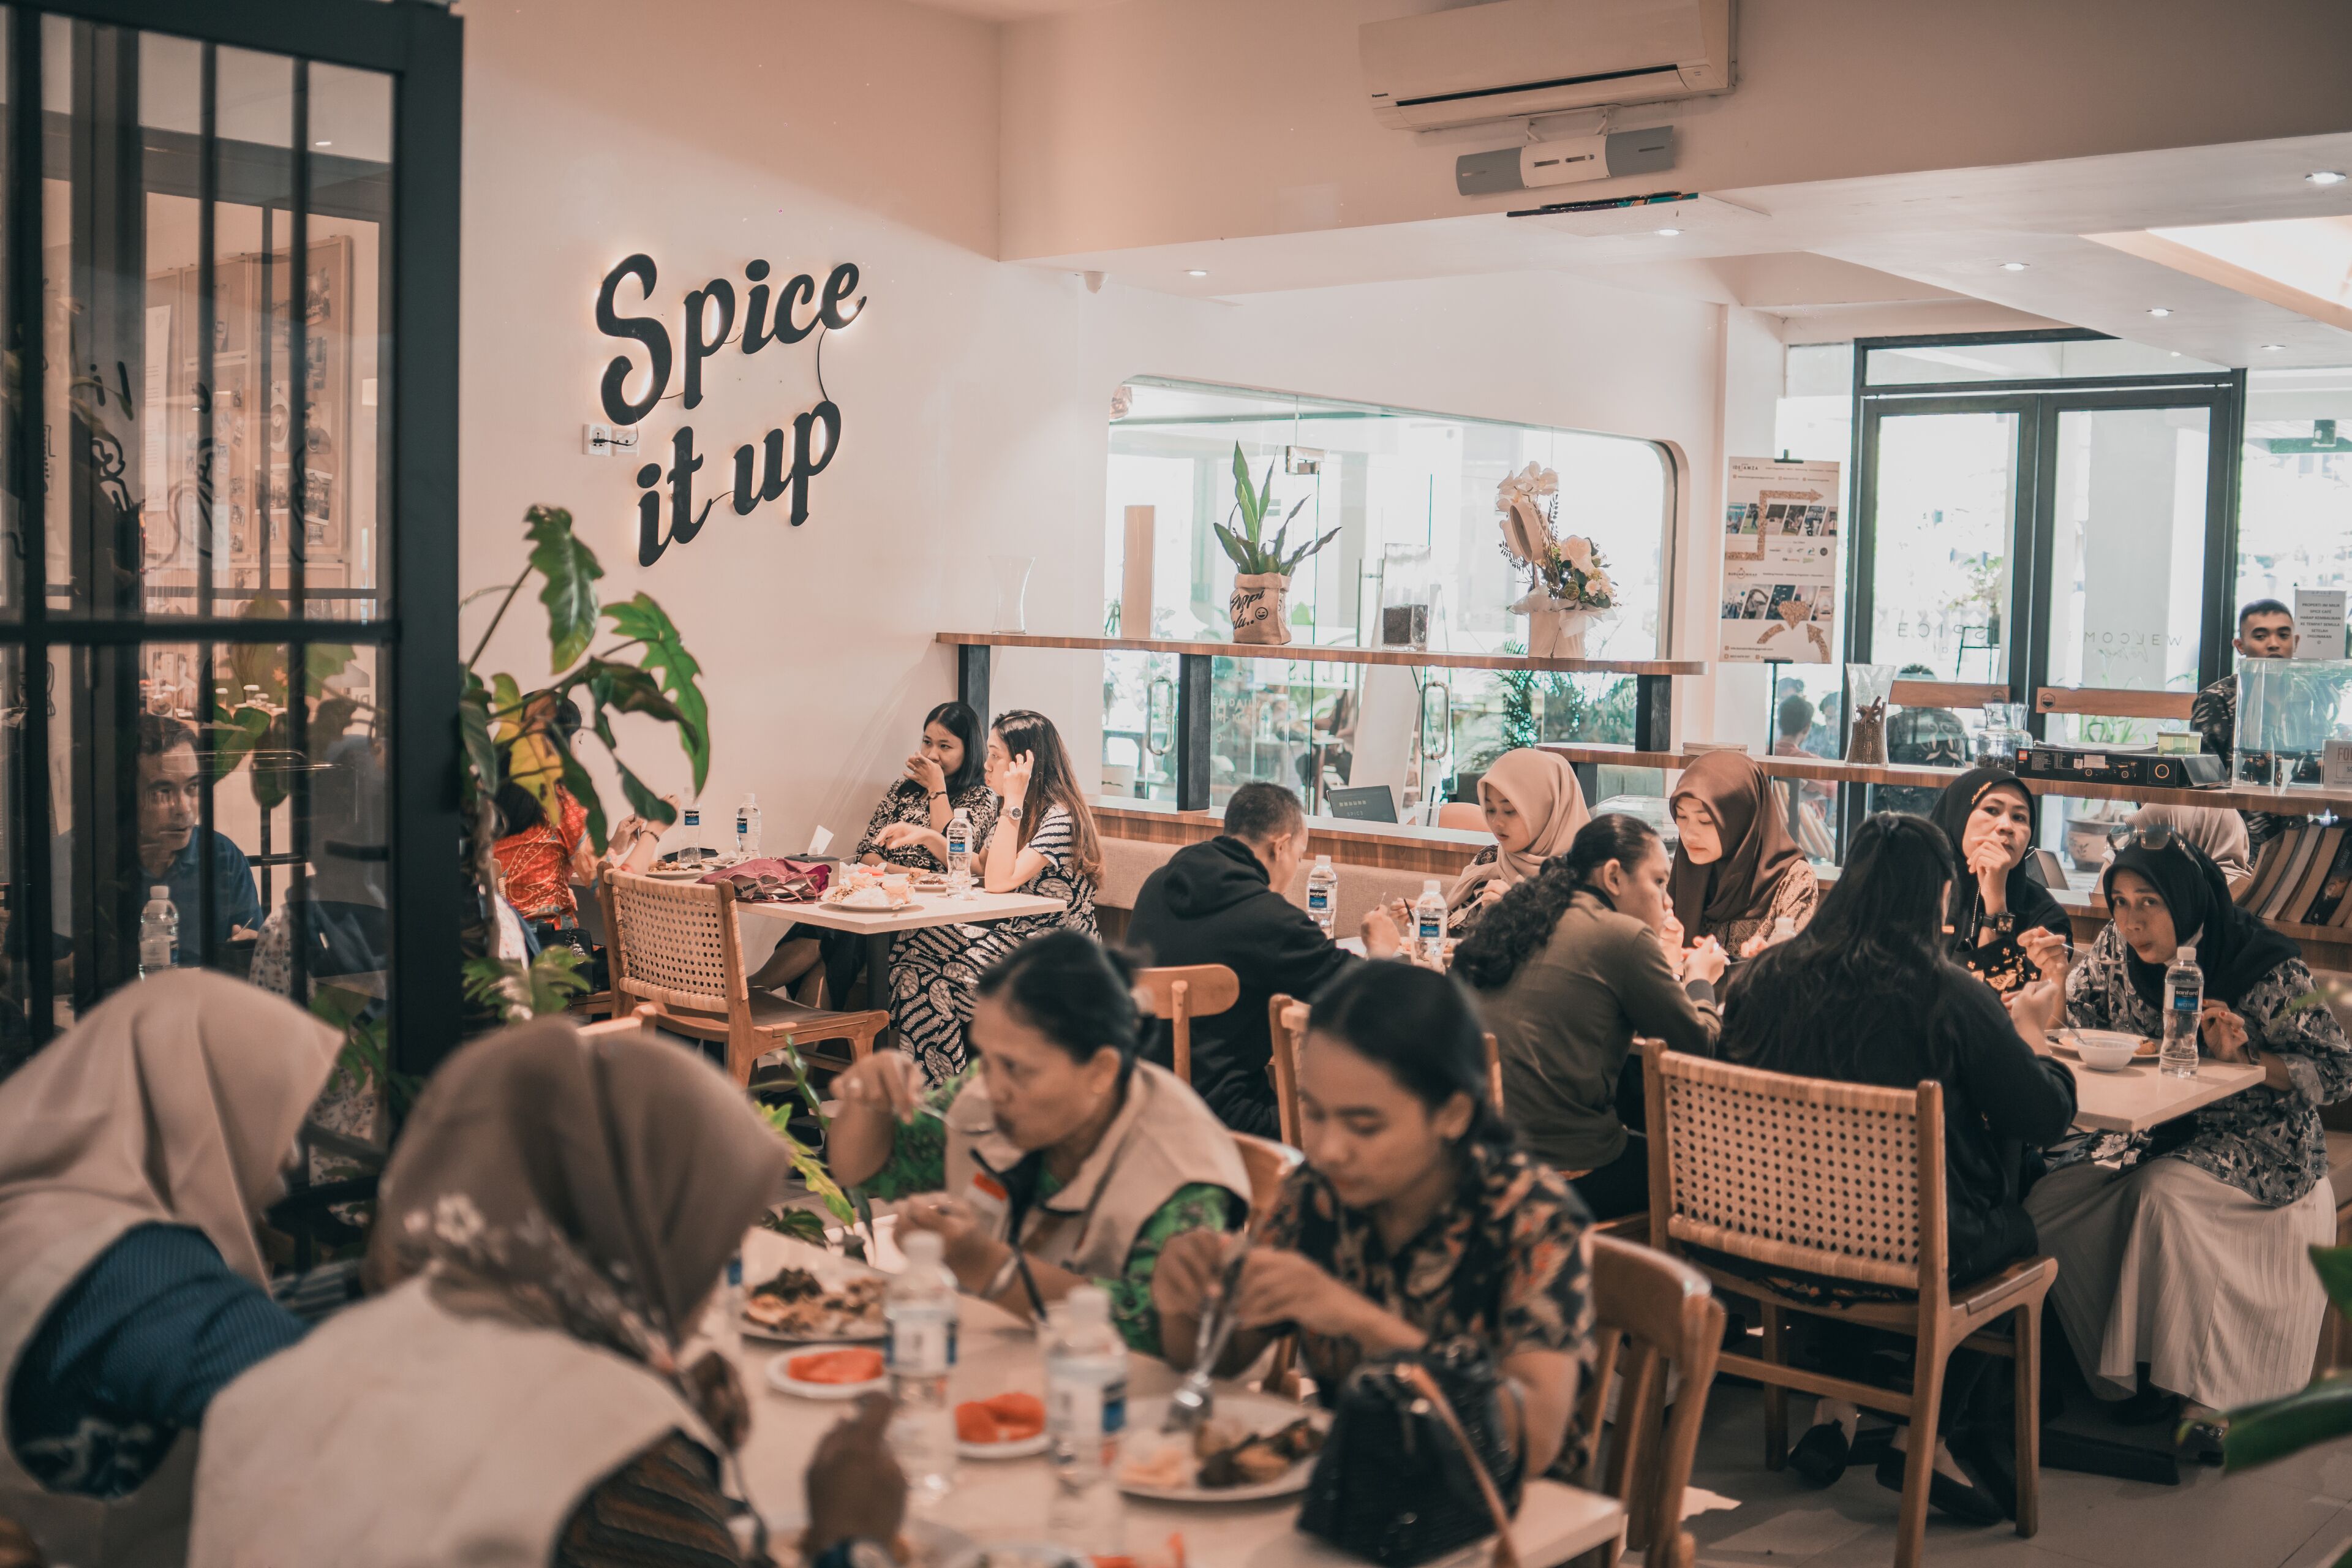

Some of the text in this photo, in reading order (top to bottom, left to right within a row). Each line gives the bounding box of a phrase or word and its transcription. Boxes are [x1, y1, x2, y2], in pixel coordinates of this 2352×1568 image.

[595, 253, 867, 426] Spice
[636, 400, 842, 567] it up
[2337, 747, 2352, 761] FO
